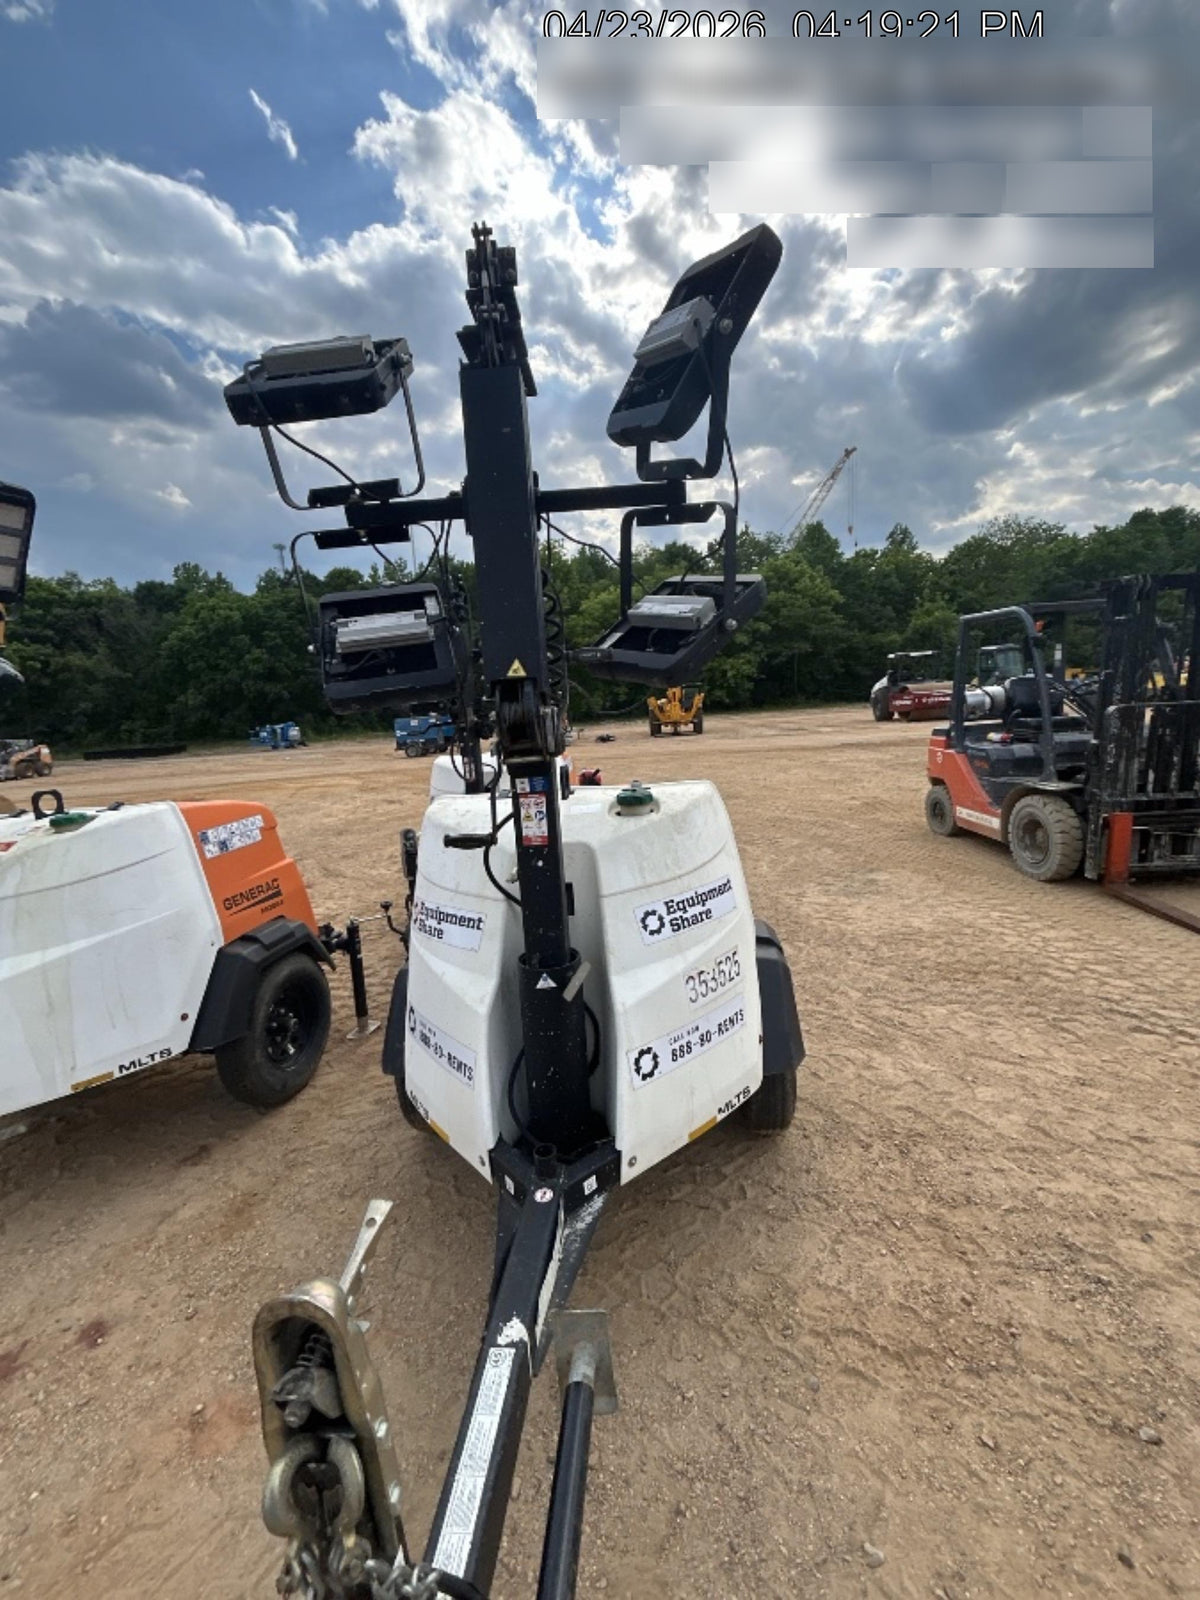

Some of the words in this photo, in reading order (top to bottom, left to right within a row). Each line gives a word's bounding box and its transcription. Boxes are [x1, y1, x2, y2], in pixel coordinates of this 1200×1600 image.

[223, 878, 280, 911] GENERAC
[664, 878, 733, 916] Equipment
[669, 908, 713, 933] Share
